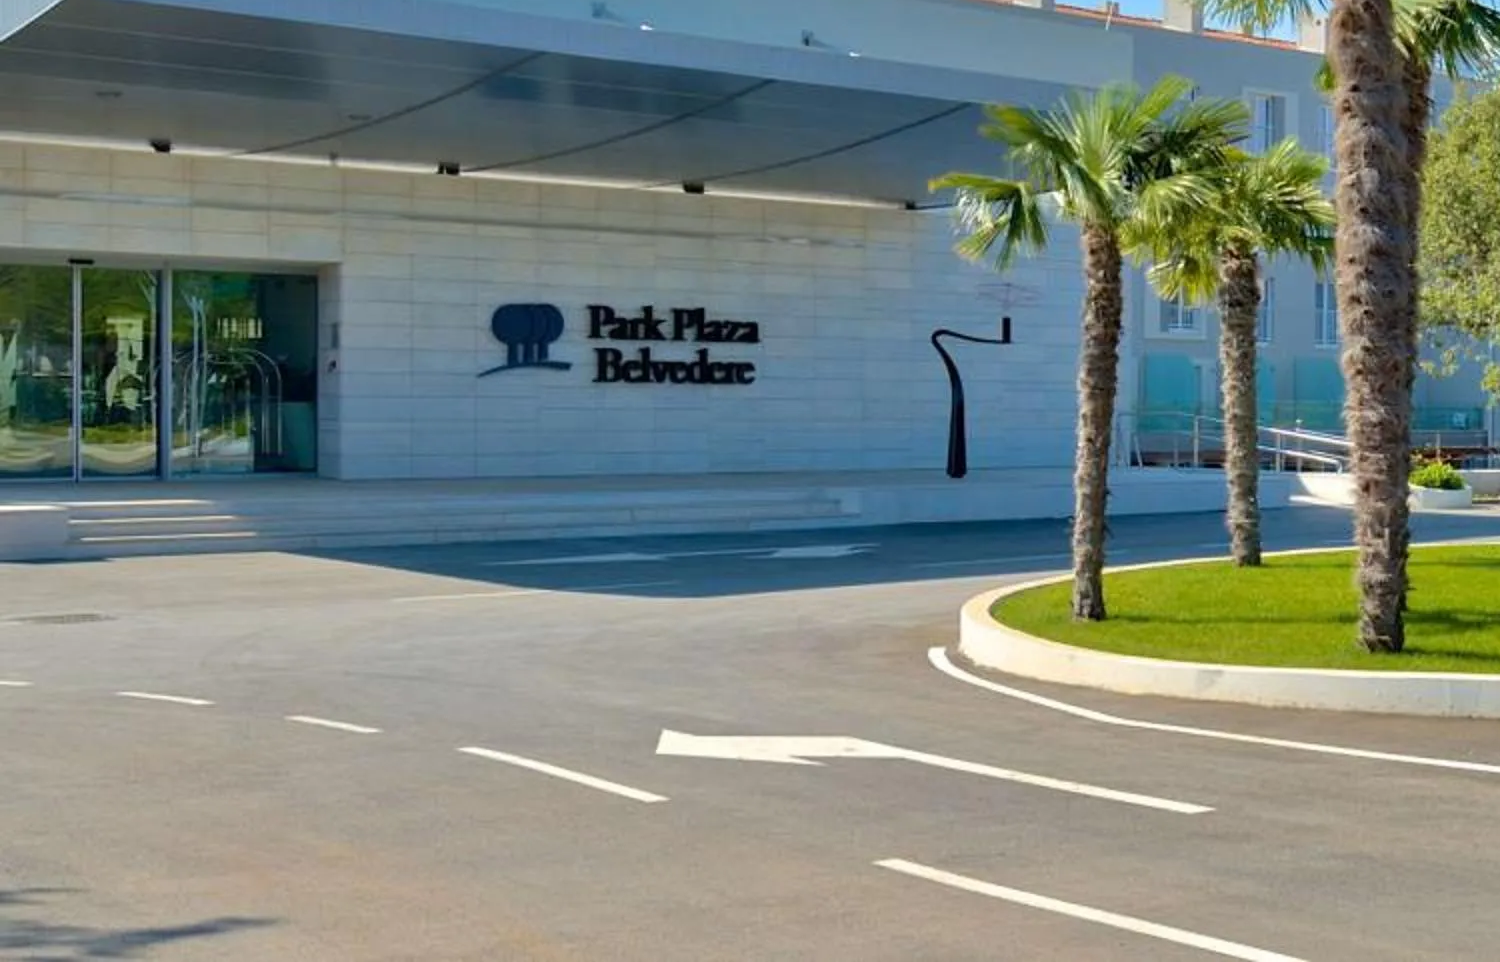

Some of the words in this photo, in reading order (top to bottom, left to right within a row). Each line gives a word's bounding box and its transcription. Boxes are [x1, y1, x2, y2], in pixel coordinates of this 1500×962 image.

[586, 305, 667, 341] Park
[671, 307, 760, 343] Plaza
[592, 346, 756, 384] Belvedere
